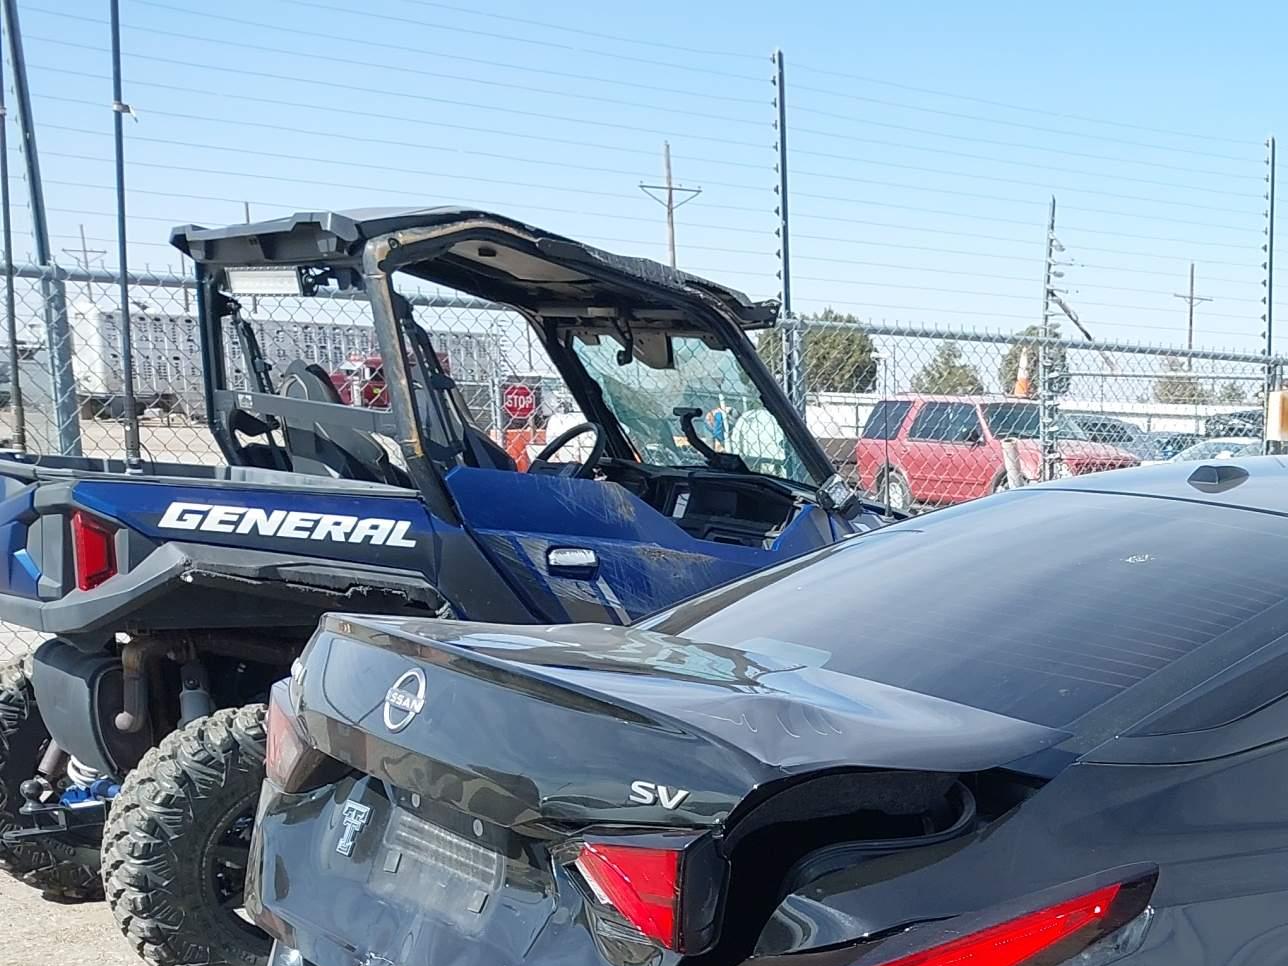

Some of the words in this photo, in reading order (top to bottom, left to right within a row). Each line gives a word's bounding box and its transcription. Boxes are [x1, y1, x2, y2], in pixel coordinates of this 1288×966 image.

[506, 394, 533, 408] STOP
[157, 501, 416, 548] GENERAL
[629, 780, 690, 810] SV
